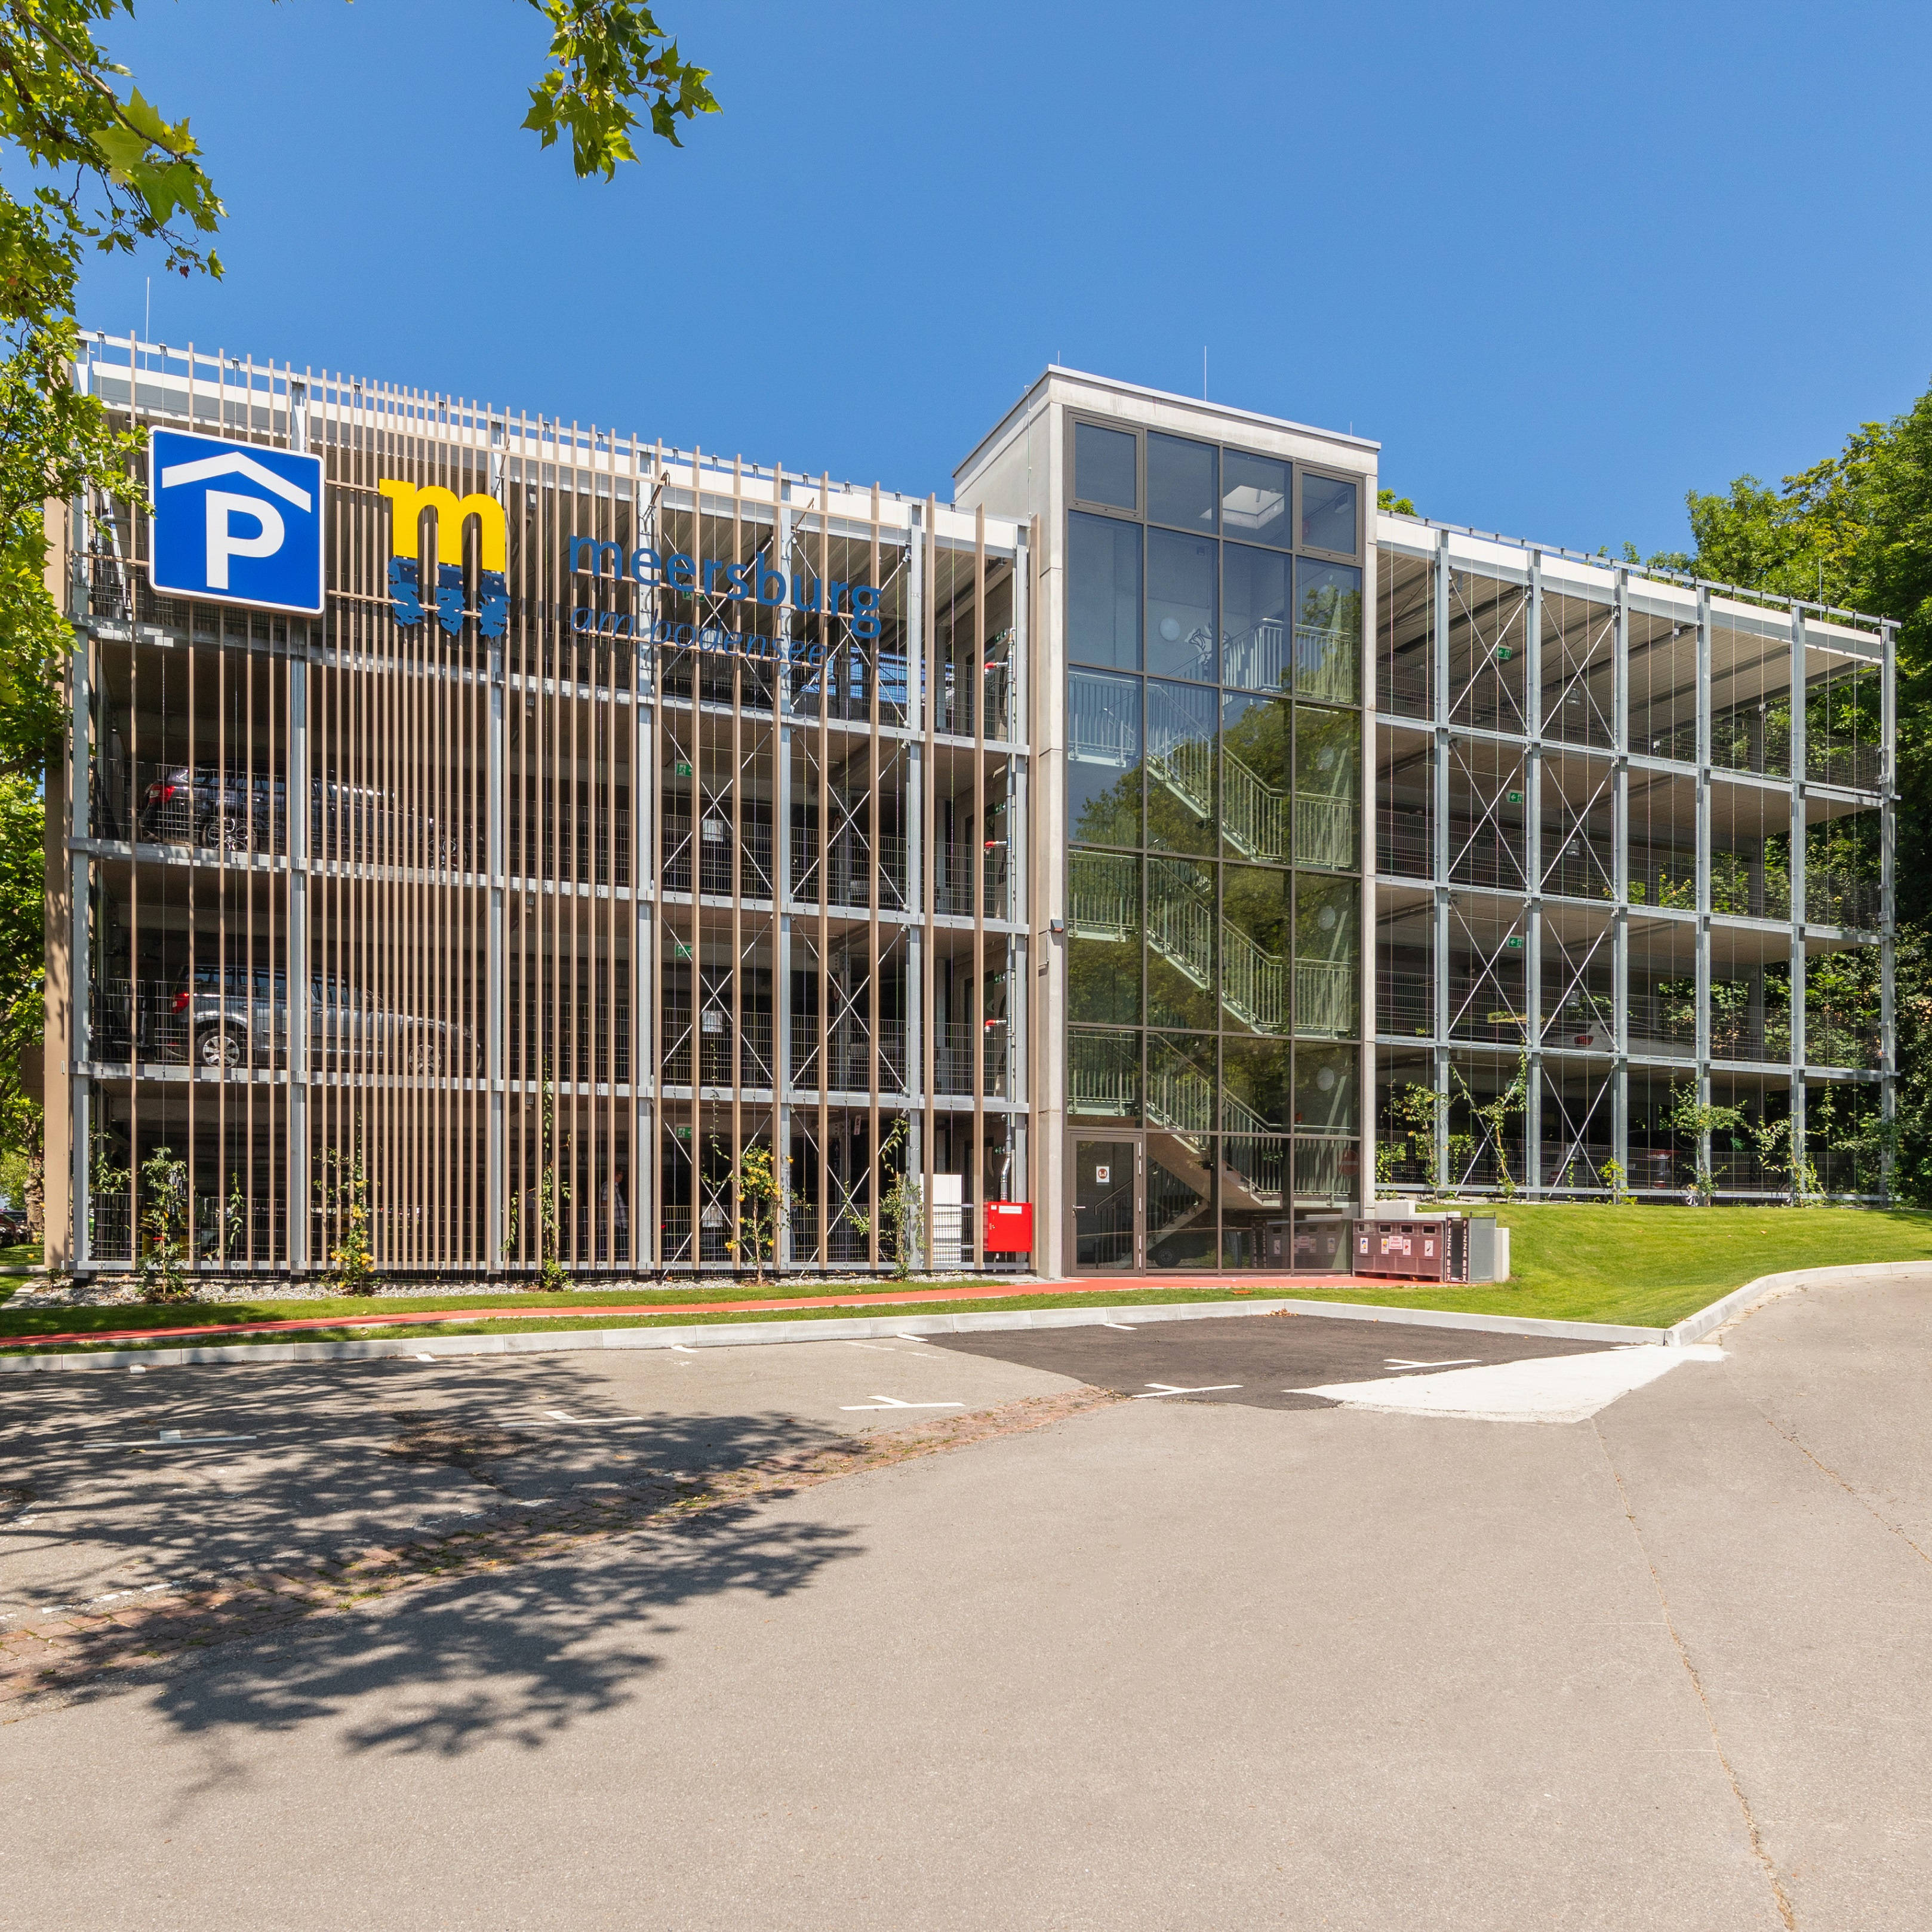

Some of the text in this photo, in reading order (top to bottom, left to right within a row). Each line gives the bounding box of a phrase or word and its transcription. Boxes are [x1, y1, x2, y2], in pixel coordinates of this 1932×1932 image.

[206, 490, 285, 590] P
[379, 478, 506, 572] m
[570, 536, 882, 639] meersburg
[571, 606, 826, 669] am bodensee
